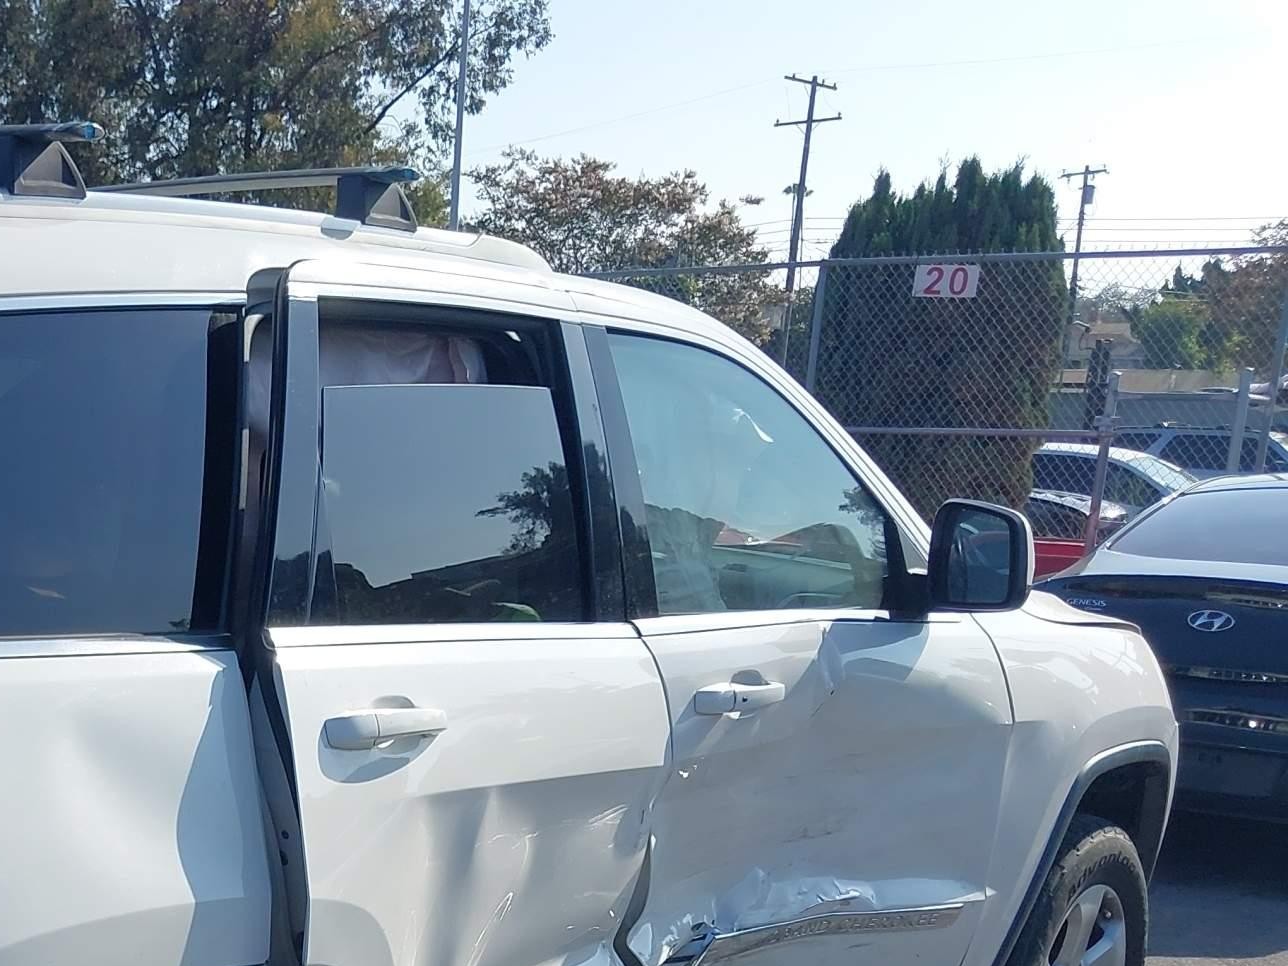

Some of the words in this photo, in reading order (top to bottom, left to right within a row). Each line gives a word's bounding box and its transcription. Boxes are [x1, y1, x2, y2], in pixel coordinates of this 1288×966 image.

[923, 266, 969, 296] 20
[1066, 598, 1107, 608] GENESIS
[839, 912, 941, 933] CHEROKEE
